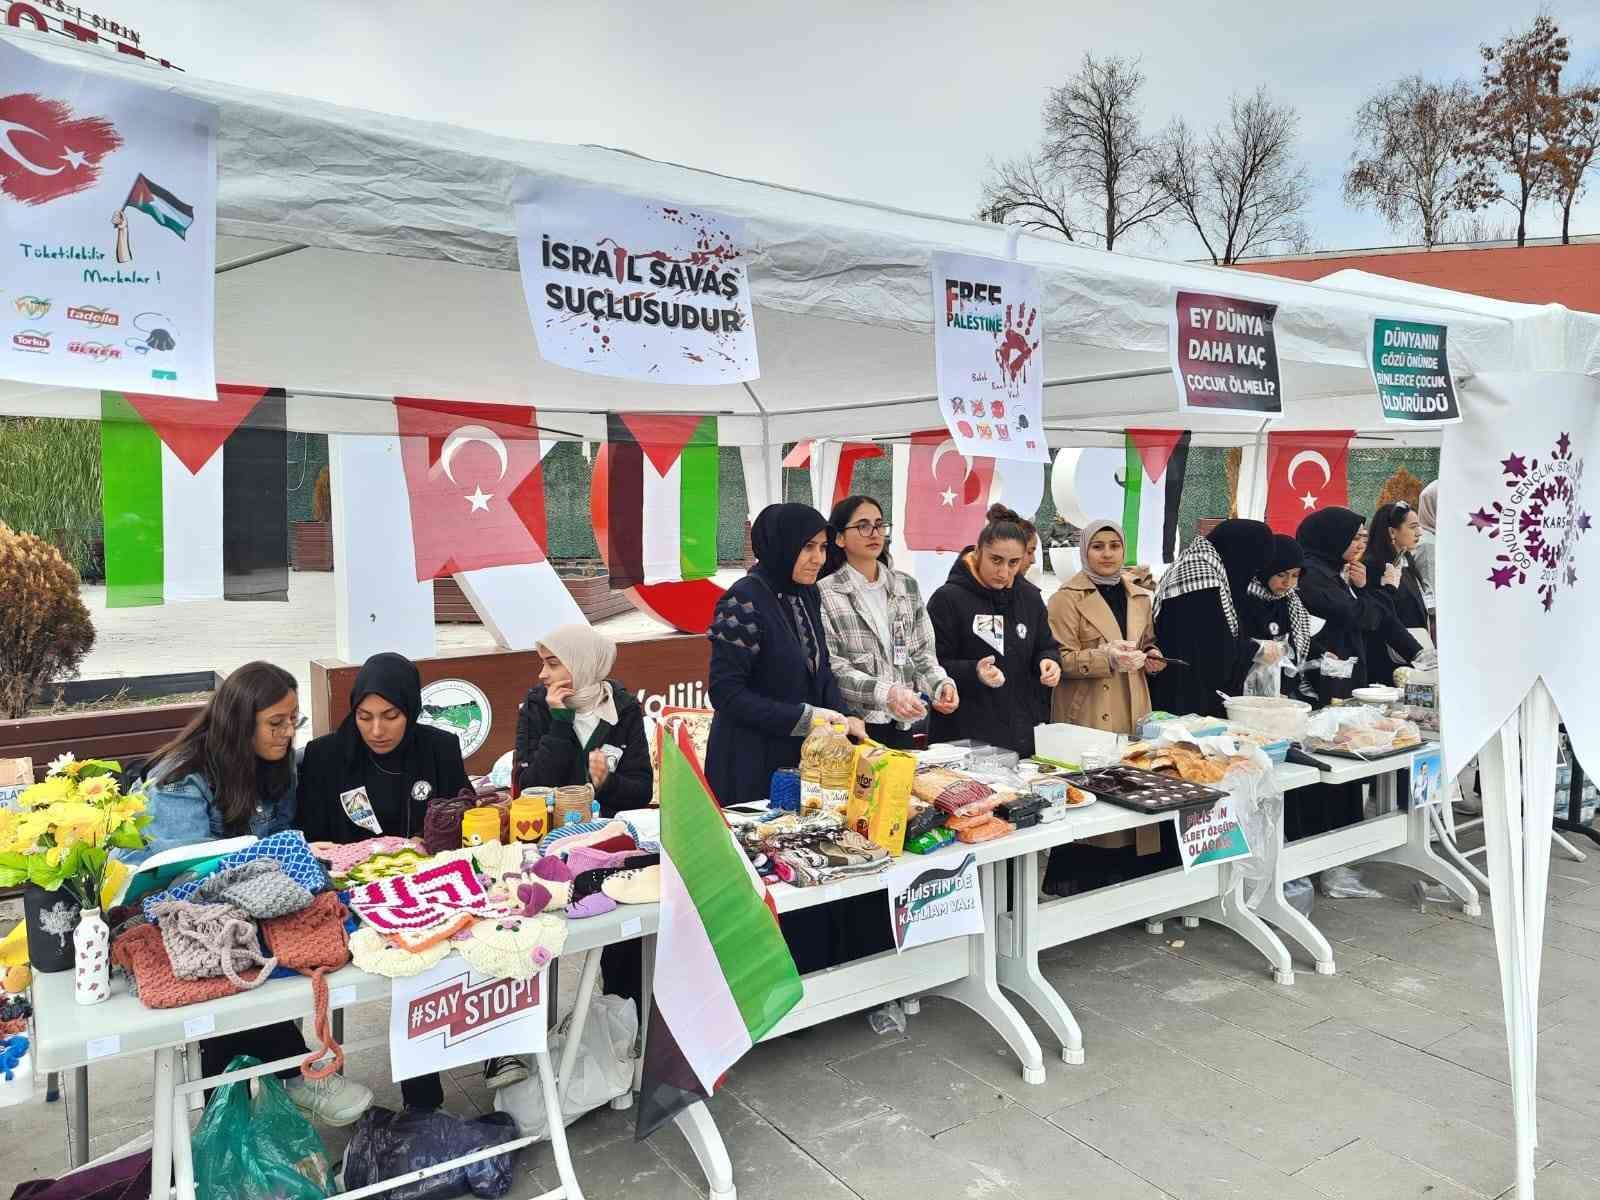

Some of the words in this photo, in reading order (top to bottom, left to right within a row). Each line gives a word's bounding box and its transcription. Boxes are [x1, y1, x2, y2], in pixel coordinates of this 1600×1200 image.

[19, 243, 105, 261] Tüketilebilir
[84, 269, 150, 284] Markalar
[650, 260, 739, 300] SAVAŞ
[946, 279, 1002, 308] FREE
[545, 283, 744, 332] SUÇLUSUDUR
[946, 313, 1003, 332] PALESTINE
[1190, 307, 1212, 329] EY
[1216, 308, 1264, 336] DÜNYA
[1383, 327, 1439, 350] DÜNYANIN
[1188, 339, 1233, 363] DAHA
[1237, 344, 1266, 370] KAÇ
[1381, 352, 1405, 367] GÖZÜ
[1406, 352, 1438, 369] ÖNÜNDE
[1187, 374, 1228, 392] ÇOCUK
[1229, 375, 1275, 396] ÖLMELİ?
[1415, 374, 1446, 388] ÇOCUK
[1382, 391, 1449, 413] ÖLDÜRÜLDÜ
[411, 989, 460, 1029] #SAY
[464, 974, 533, 1025] STOP!
